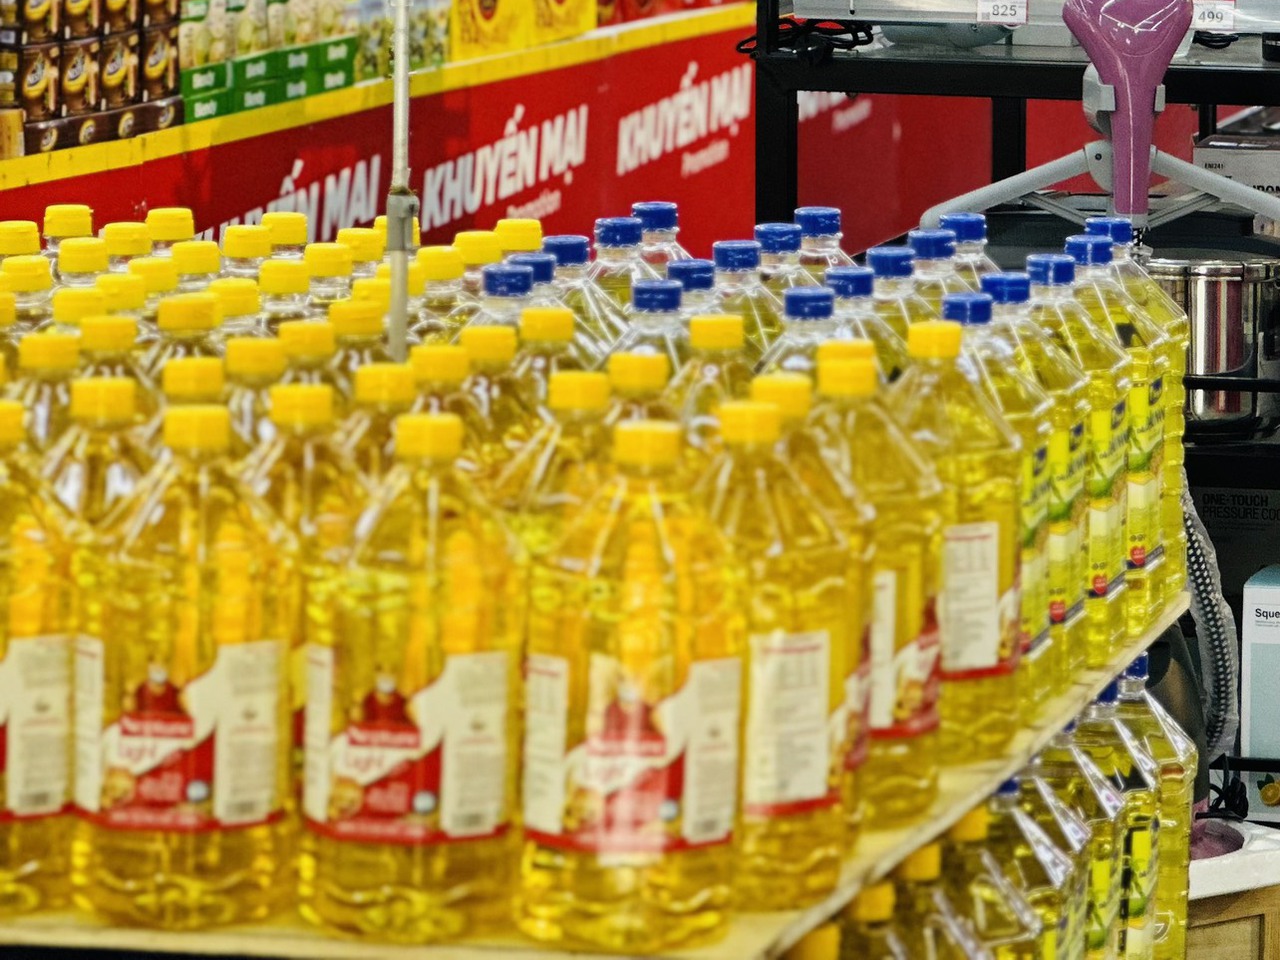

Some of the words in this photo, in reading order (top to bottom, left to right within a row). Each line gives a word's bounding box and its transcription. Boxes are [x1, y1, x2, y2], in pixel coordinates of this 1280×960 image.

[992, 4, 1017, 17] 825
[1198, 10, 1224, 23] 499
[617, 61, 710, 177] KHUYẾN
[421, 103, 539, 233] KHUYẾN
[539, 103, 589, 186] MẠI
[1201, 493, 1269, 507] ONE-TOUCH
[1202, 505, 1259, 520] PRESSURE
